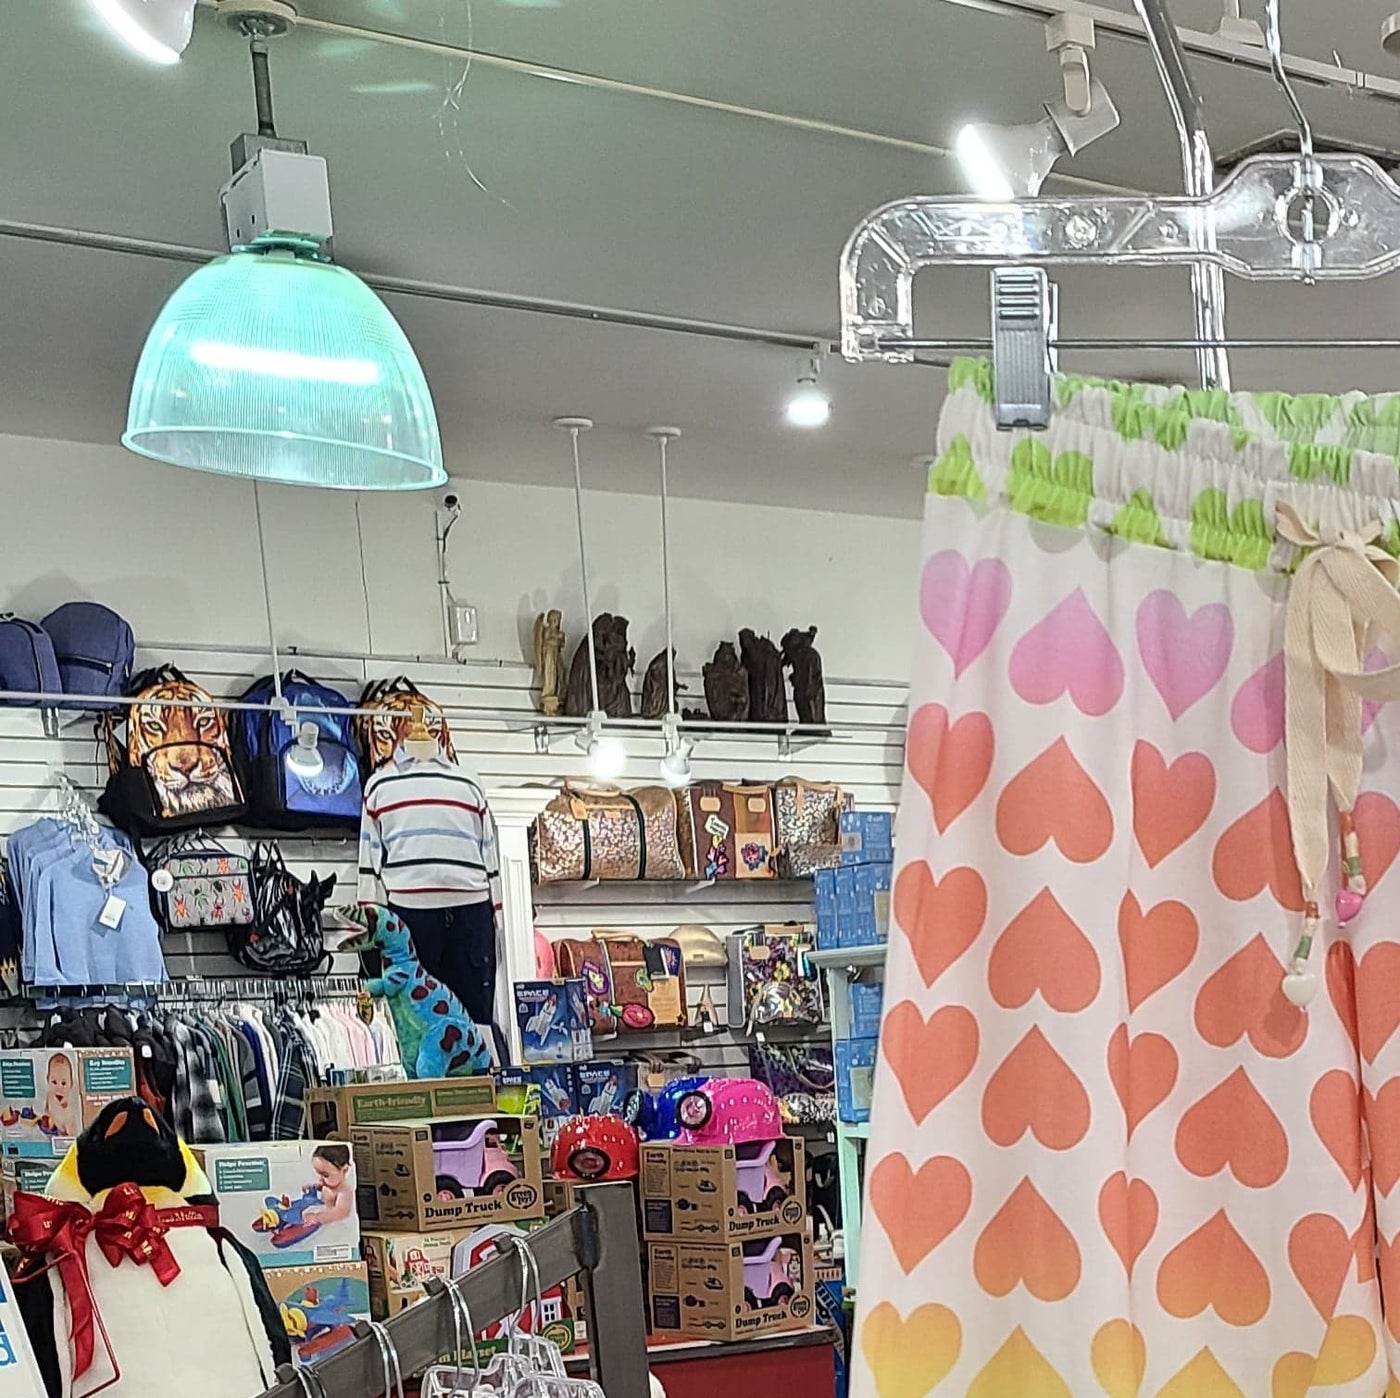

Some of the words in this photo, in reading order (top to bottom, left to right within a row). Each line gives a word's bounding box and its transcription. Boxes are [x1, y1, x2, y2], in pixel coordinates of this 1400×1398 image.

[424, 1204, 463, 1218] Dump
[465, 1199, 503, 1214] Truck
[729, 1219, 754, 1233] Dump
[757, 1215, 780, 1228] Truck
[735, 1314, 761, 1329] Dump
[763, 1310, 788, 1323] Truck
